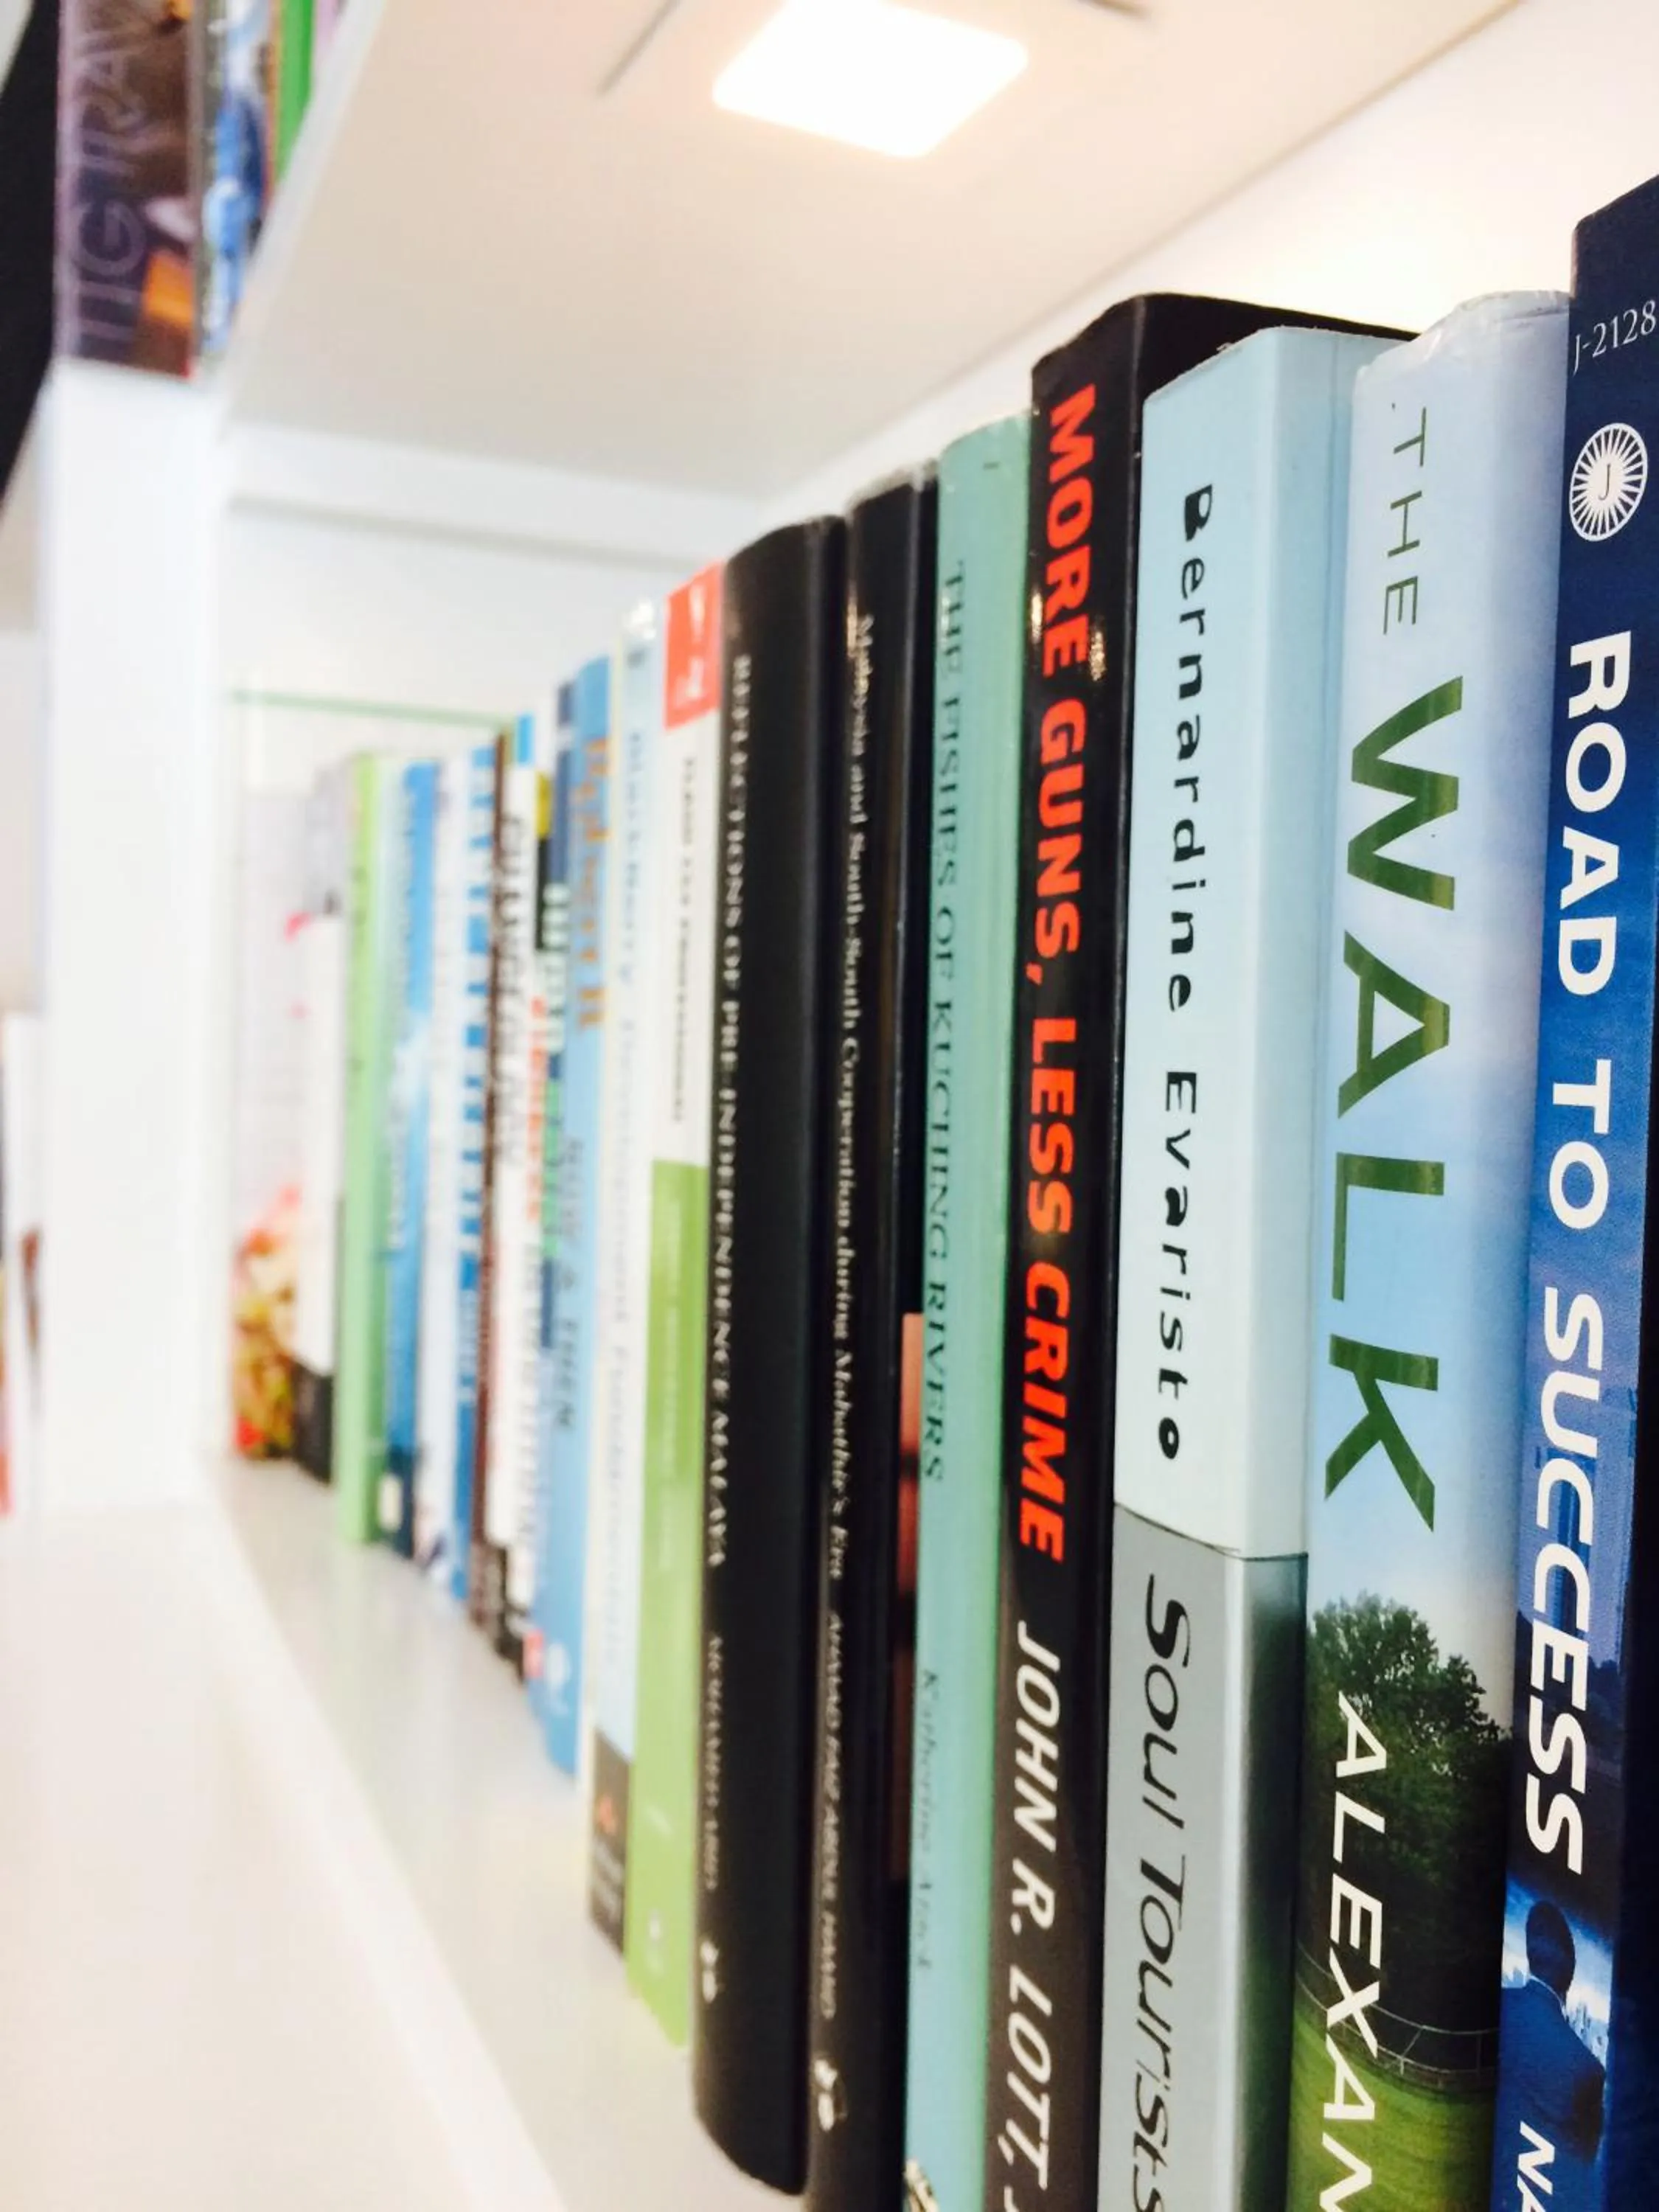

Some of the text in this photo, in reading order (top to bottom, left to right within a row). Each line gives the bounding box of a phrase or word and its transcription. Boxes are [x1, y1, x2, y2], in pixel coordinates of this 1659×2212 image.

[1572, 299, 1658, 376] J-2128
[725, 655, 751, 928] REFLECTIONS
[847, 764, 870, 825] and
[721, 935, 742, 990] OF
[841, 832, 867, 1029] South-South
[922, 560, 966, 1484] THE FISHES OF KUCHING RIVERS
[1018, 383, 1096, 1565] MORE GUNS, LESS CRIME
[1158, 484, 1214, 1461] Bernardine Evaristo
[1324, 407, 1464, 1533] THE WALK
[835, 1037, 861, 1227] Cooperation
[832, 1235, 856, 1340] during
[1525, 631, 1631, 1875] ROAD TO SUCCESS
[706, 1411, 730, 1568] MALAYA
[830, 1526, 848, 1579] Era
[825, 1611, 844, 1729] AHMAD
[997, 1621, 1061, 2191] JOHN R. LOTT,
[1133, 1573, 1192, 2212] Soul Tourists
[1319, 1690, 1388, 2212] ALEXAN
